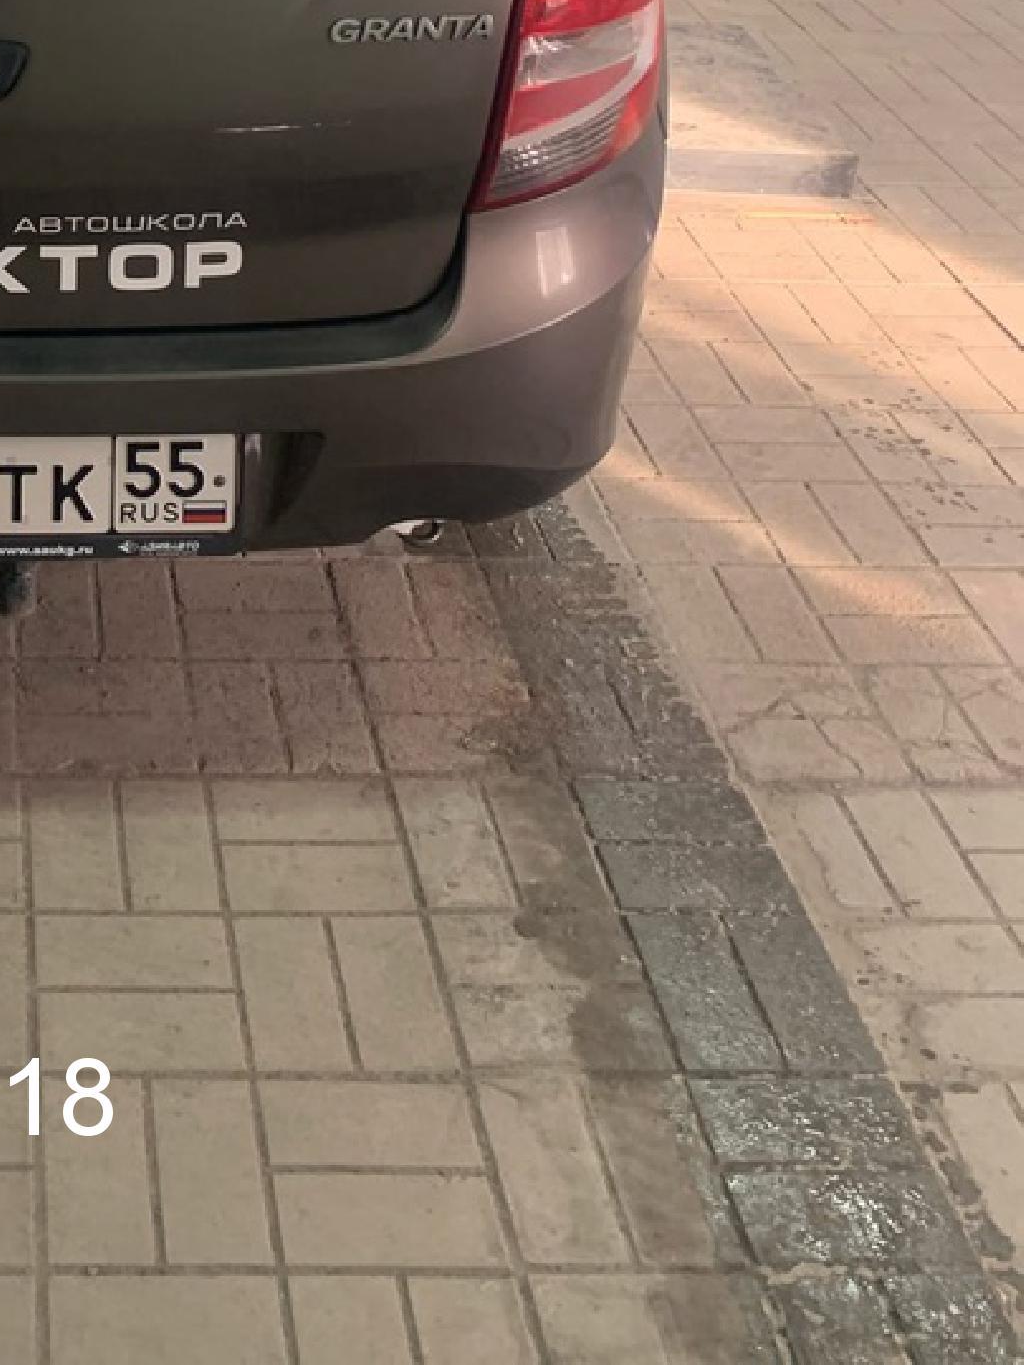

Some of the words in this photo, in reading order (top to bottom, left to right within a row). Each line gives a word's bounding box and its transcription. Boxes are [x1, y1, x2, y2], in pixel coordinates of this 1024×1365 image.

[330, 14, 495, 43] GRANTA
[14, 211, 249, 235] АВТОШКОЛА
[124, 441, 205, 498] 55
[120, 502, 180, 524] RUS
